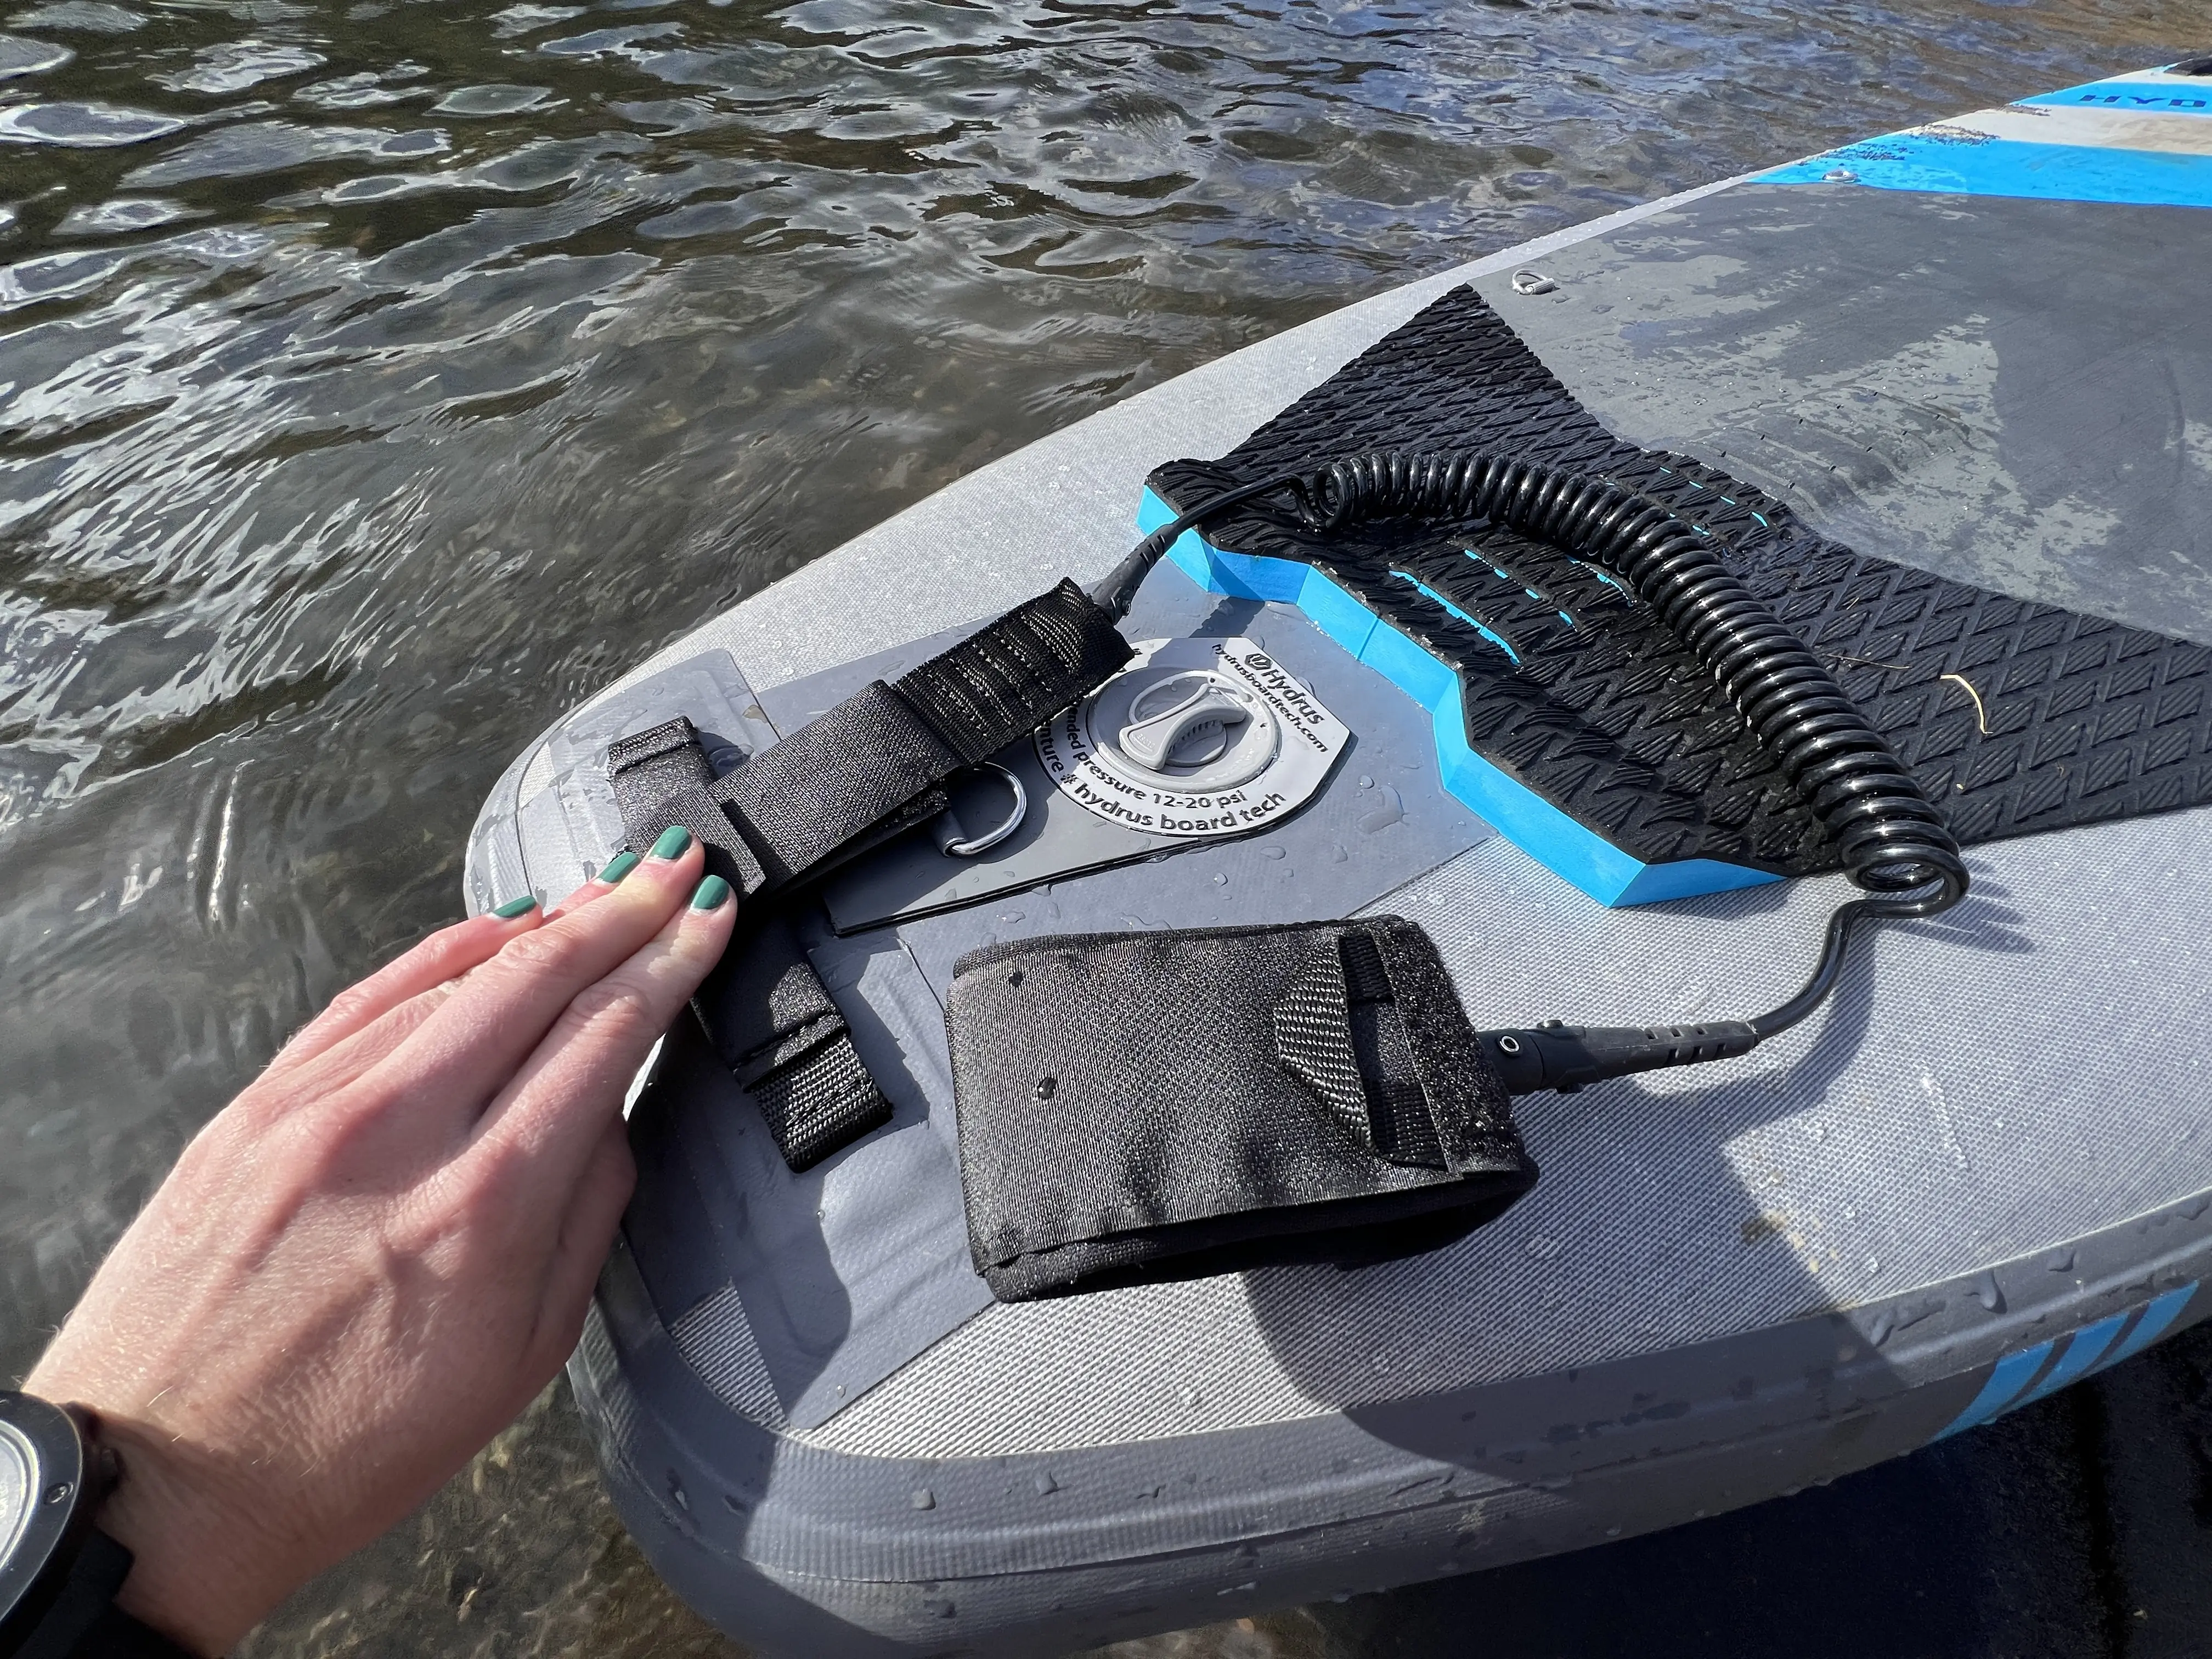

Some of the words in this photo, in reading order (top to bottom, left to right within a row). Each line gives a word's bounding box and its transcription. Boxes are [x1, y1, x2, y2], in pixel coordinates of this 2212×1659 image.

[2079, 94, 2207, 108] HYD
[1211, 644, 1329, 753] hydrusboardtech.com
[1260, 668, 1325, 725] Hydrus
[1073, 751, 1147, 800] pressure
[1153, 793, 1212, 809] 12-20
[1216, 789, 1248, 809] psi
[1160, 811, 1238, 831] board
[1239, 792, 1286, 822] tech
